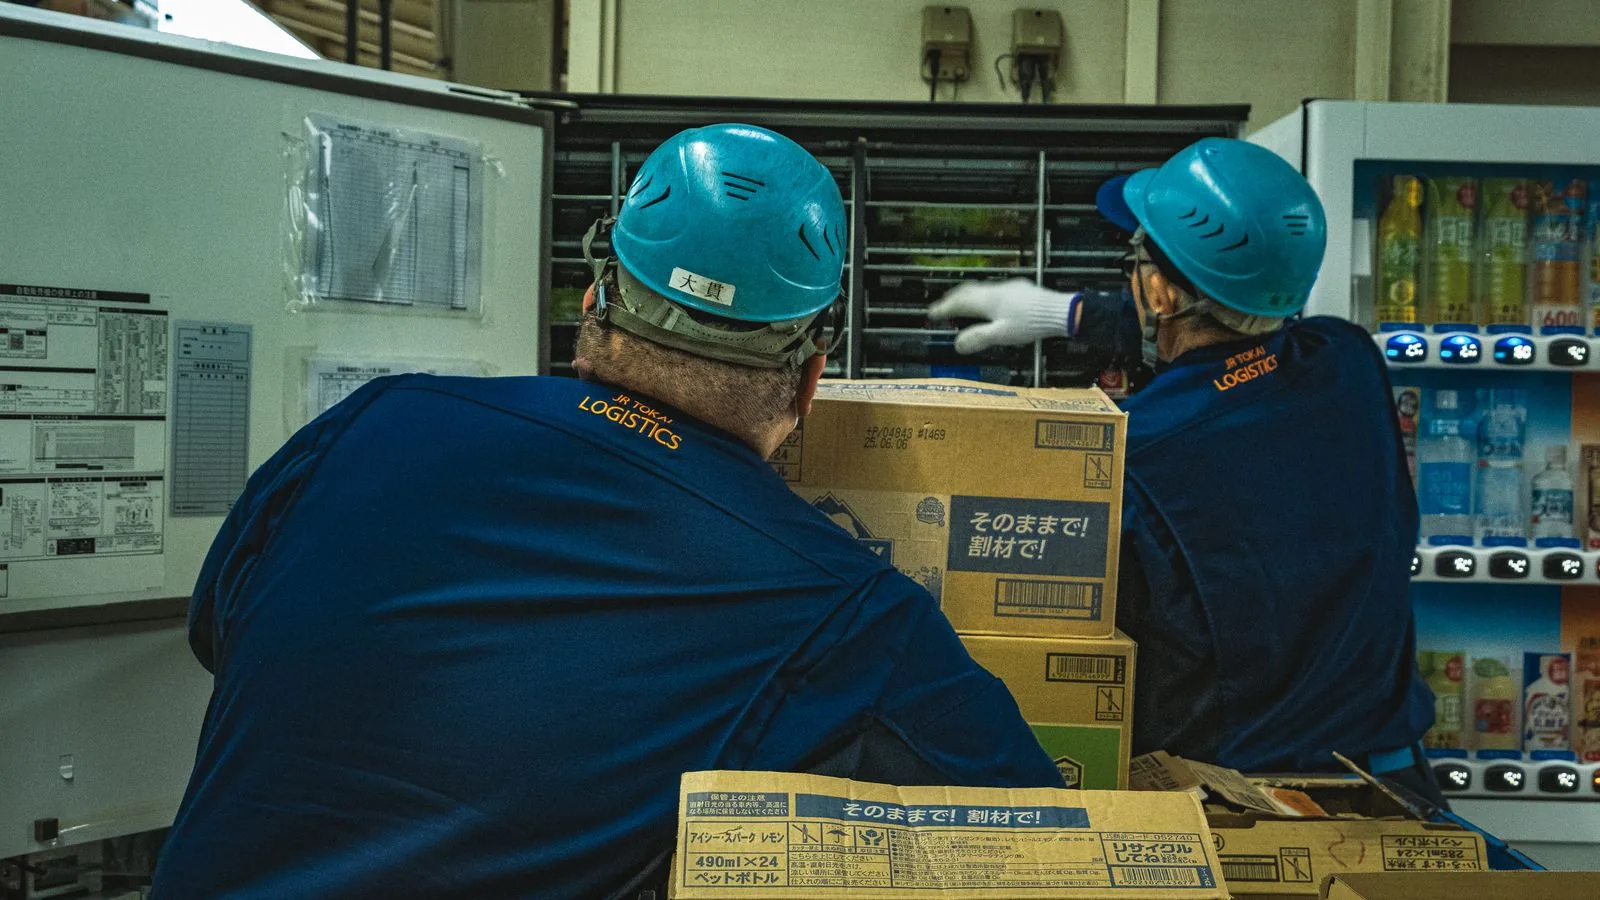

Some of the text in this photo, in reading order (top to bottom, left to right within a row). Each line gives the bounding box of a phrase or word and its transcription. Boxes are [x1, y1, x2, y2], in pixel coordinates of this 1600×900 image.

[612, 393, 674, 424] JR TOKAI
[577, 395, 683, 451] LOGISTICS
[969, 510, 1090, 539] そのままで!
[967, 534, 1048, 561] 割材で!
[710, 793, 766, 802] 保管上の注意
[841, 802, 1041, 825] そのままで! 割材で!
[760, 831, 785, 844] レモン
[1394, 837, 1464, 848] ペットボトル
[1112, 842, 1194, 854] リサイクル
[1396, 848, 1464, 859] 285ml×24
[695, 855, 779, 868] 490ml×24
[1114, 852, 1160, 863] してね
[1386, 859, 1417, 869] 天然水
[694, 871, 780, 885] ペットボトル
